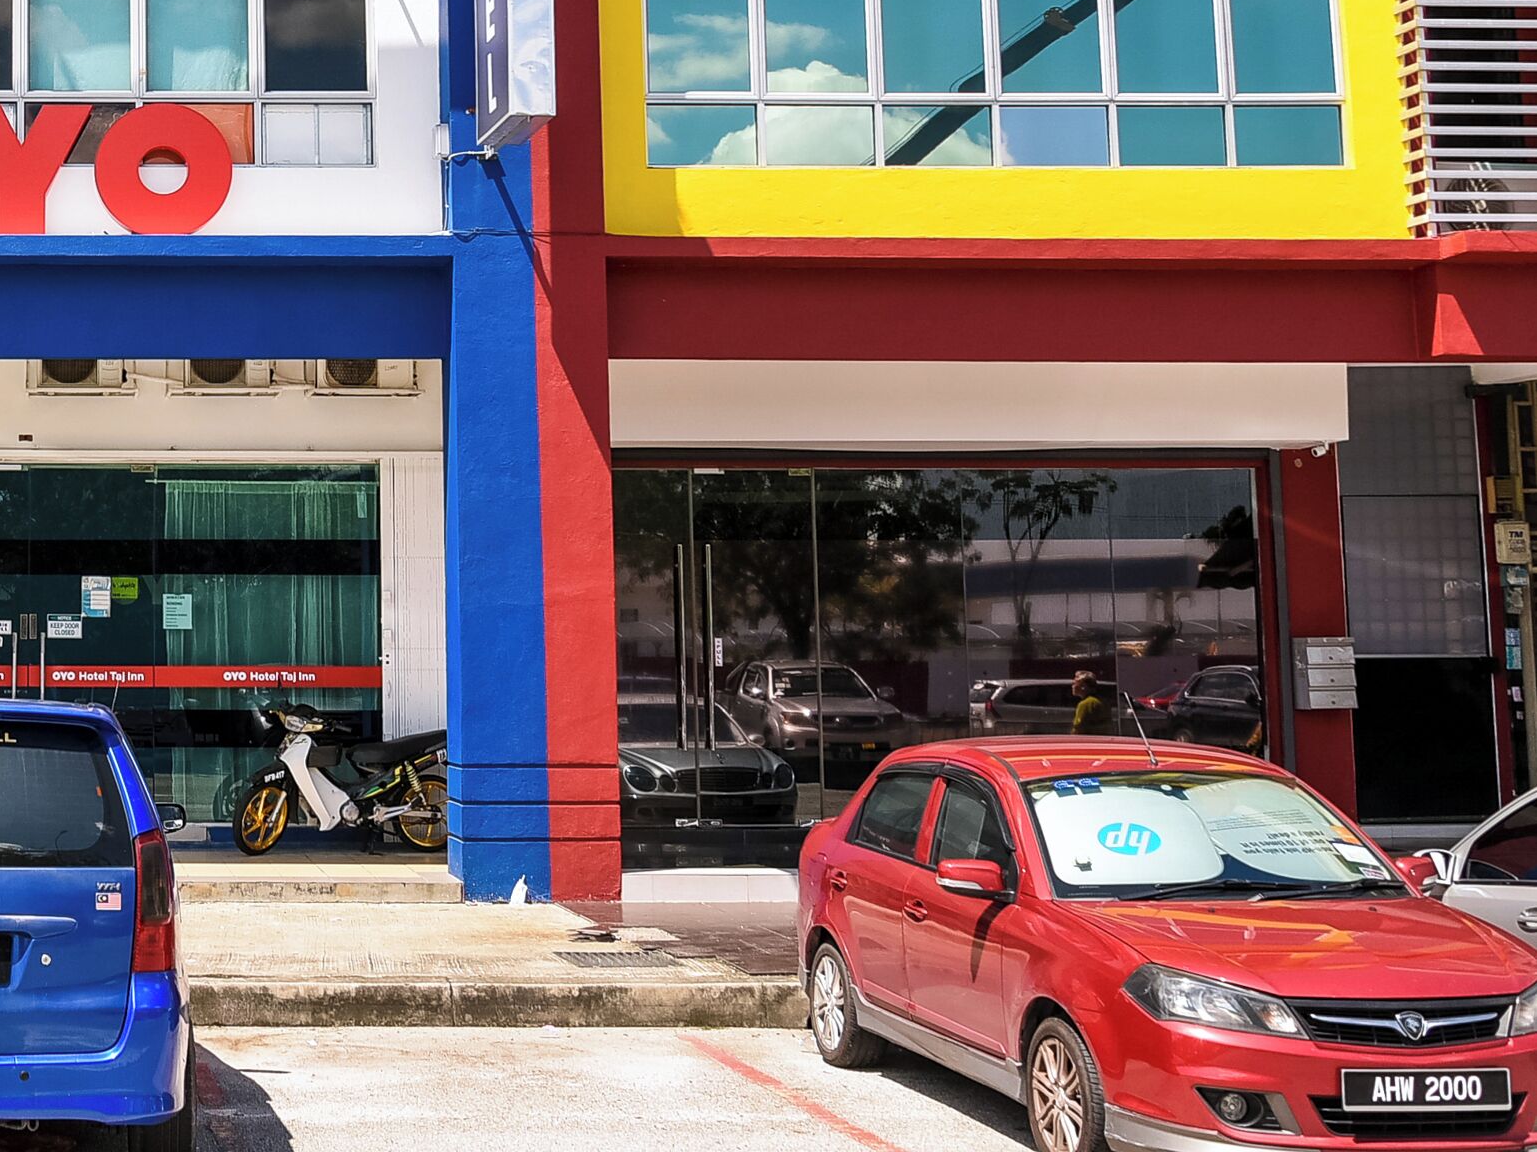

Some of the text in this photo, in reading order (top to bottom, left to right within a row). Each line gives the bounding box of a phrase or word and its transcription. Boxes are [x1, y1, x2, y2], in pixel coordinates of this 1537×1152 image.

[1508, 530, 1524, 539] TM
[65, 622, 80, 630] DOOR
[54, 628, 76, 637] CLOSED
[51, 671, 76, 682] OYO
[78, 671, 108, 682] Hotel
[126, 672, 145, 682] Inn
[222, 671, 247, 682] OYO
[249, 671, 279, 682] Hotel
[298, 672, 316, 682] Inn
[1371, 1074, 1483, 1103] AHW 2000
